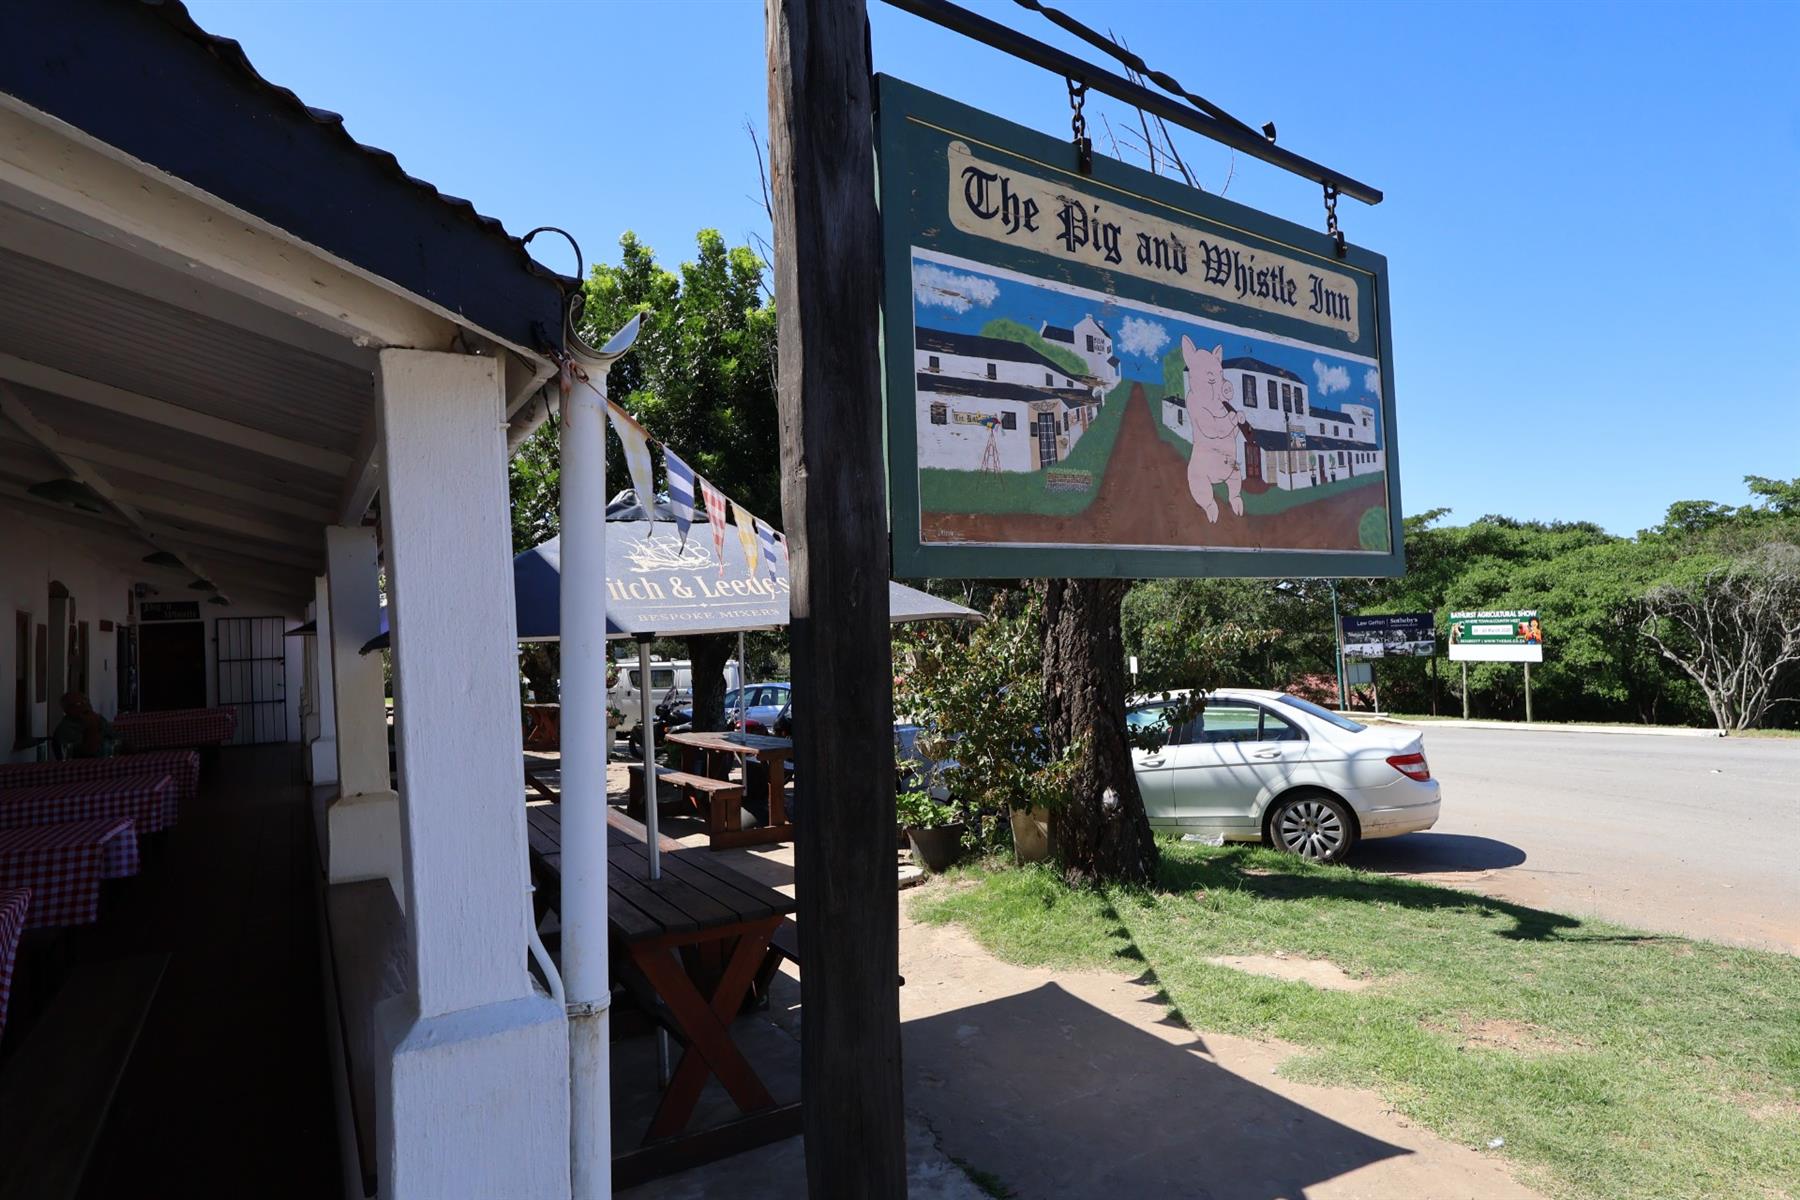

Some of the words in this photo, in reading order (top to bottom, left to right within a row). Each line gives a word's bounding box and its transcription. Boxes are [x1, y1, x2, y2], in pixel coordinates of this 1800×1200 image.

[961, 166, 1040, 235] The
[1056, 194, 1123, 265] Pig
[1136, 232, 1188, 275] and
[1199, 239, 1298, 307] Whistle
[1308, 273, 1352, 322] Inn
[605, 576, 664, 601] itch
[669, 576, 697, 599] &
[638, 610, 715, 622] BESPOKE
[719, 607, 780, 619] MIXERS
[1477, 610, 1517, 618] AGRICULTURAL
[1517, 609, 1537, 617] SHOW
